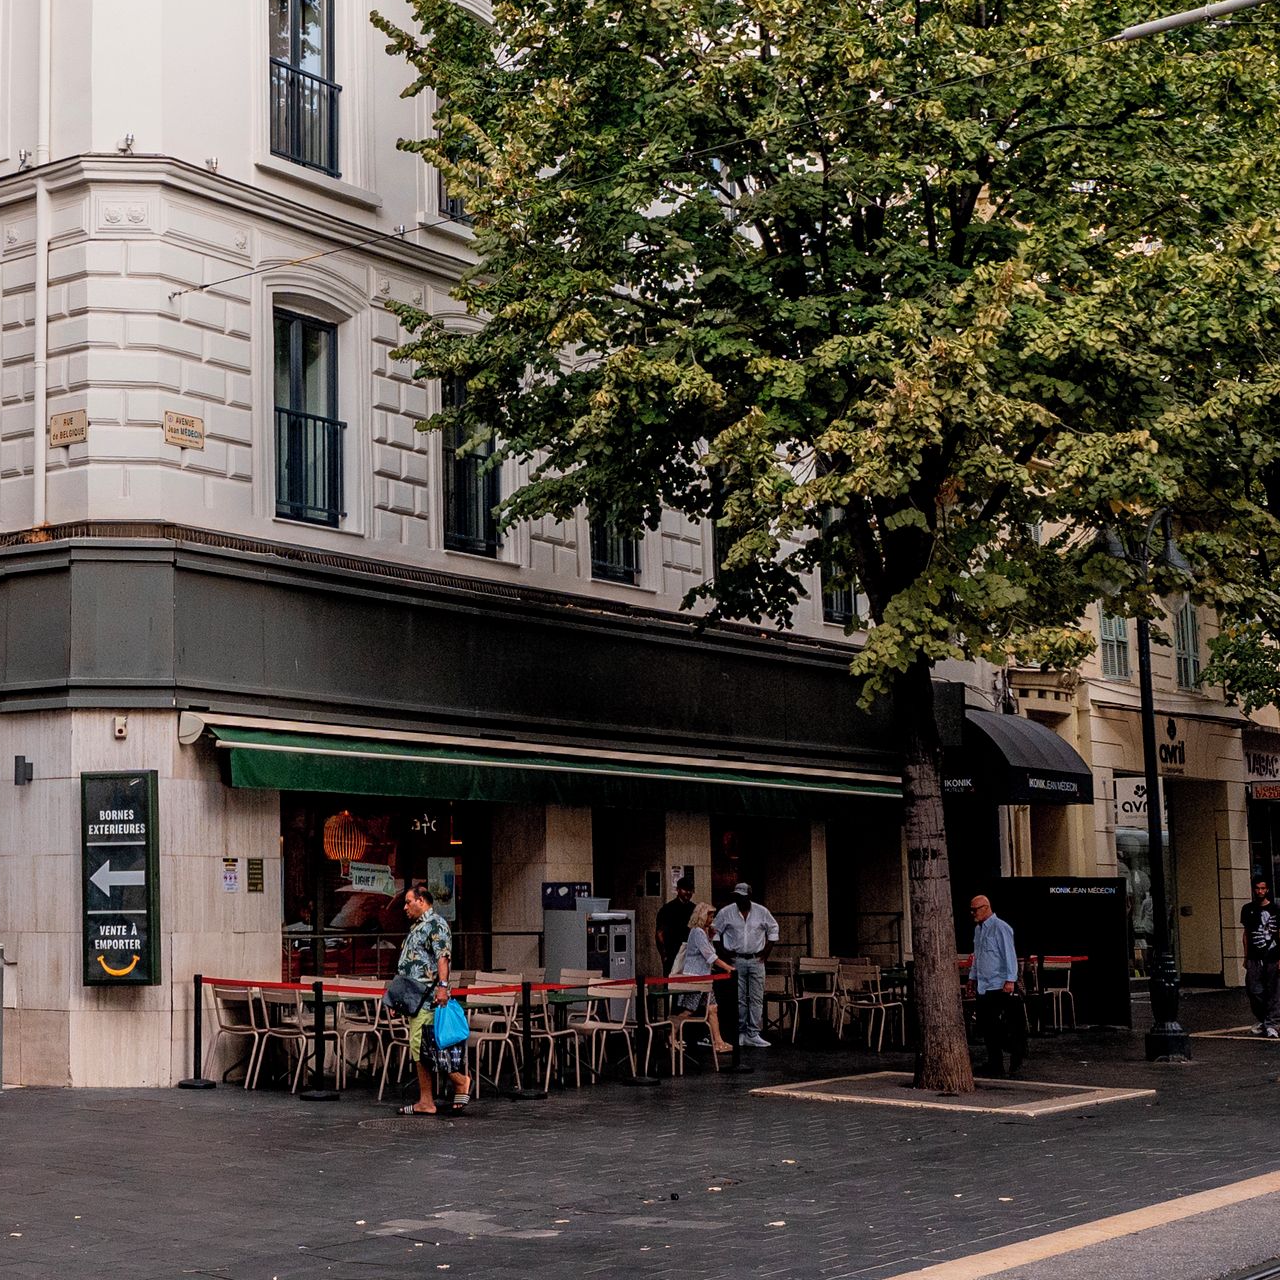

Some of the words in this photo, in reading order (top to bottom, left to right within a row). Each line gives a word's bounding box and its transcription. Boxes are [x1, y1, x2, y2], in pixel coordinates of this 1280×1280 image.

[63, 417, 73, 426] RUE
[175, 417, 195, 428] AVENUE
[60, 427, 84, 439] BELGIQUE
[1159, 740, 1185, 764] avril
[1246, 753, 1279, 778] TABAC
[944, 778, 972, 787] IKONIK
[1029, 778, 1045, 789] IKONIK
[1122, 801, 1148, 813] avr
[99, 809, 134, 821] BORNES
[88, 823, 146, 835] EXTERIEURES
[1087, 886, 1116, 894] MÉDECIN
[99, 924, 127, 936] VENTE
[131, 922, 138, 936] À
[94, 939, 141, 950] EMPORTER
